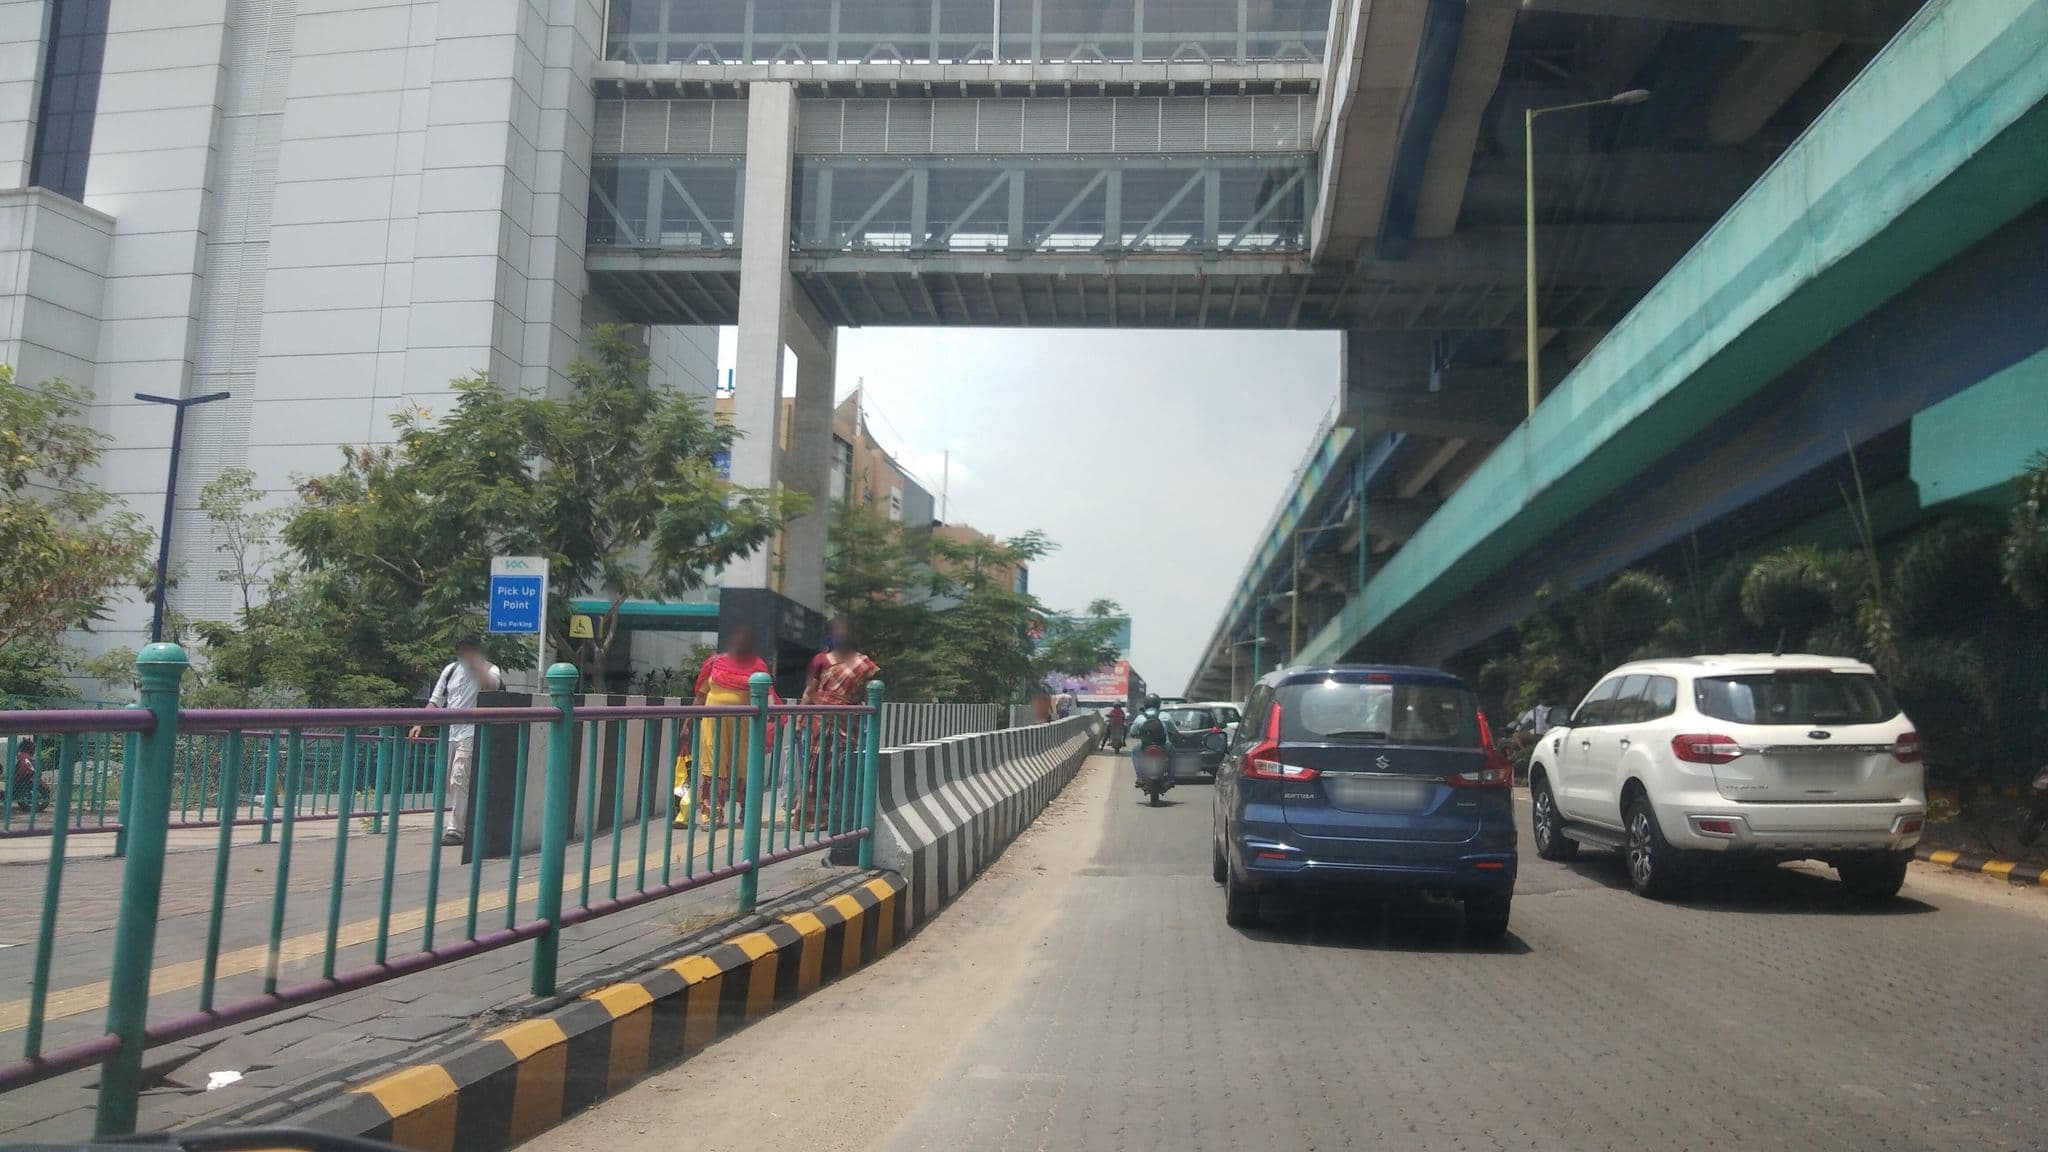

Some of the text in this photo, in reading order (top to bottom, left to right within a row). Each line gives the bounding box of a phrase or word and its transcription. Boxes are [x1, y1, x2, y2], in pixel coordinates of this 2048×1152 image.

[497, 586, 535, 598] Pick Up
[503, 600, 529, 610] Point
